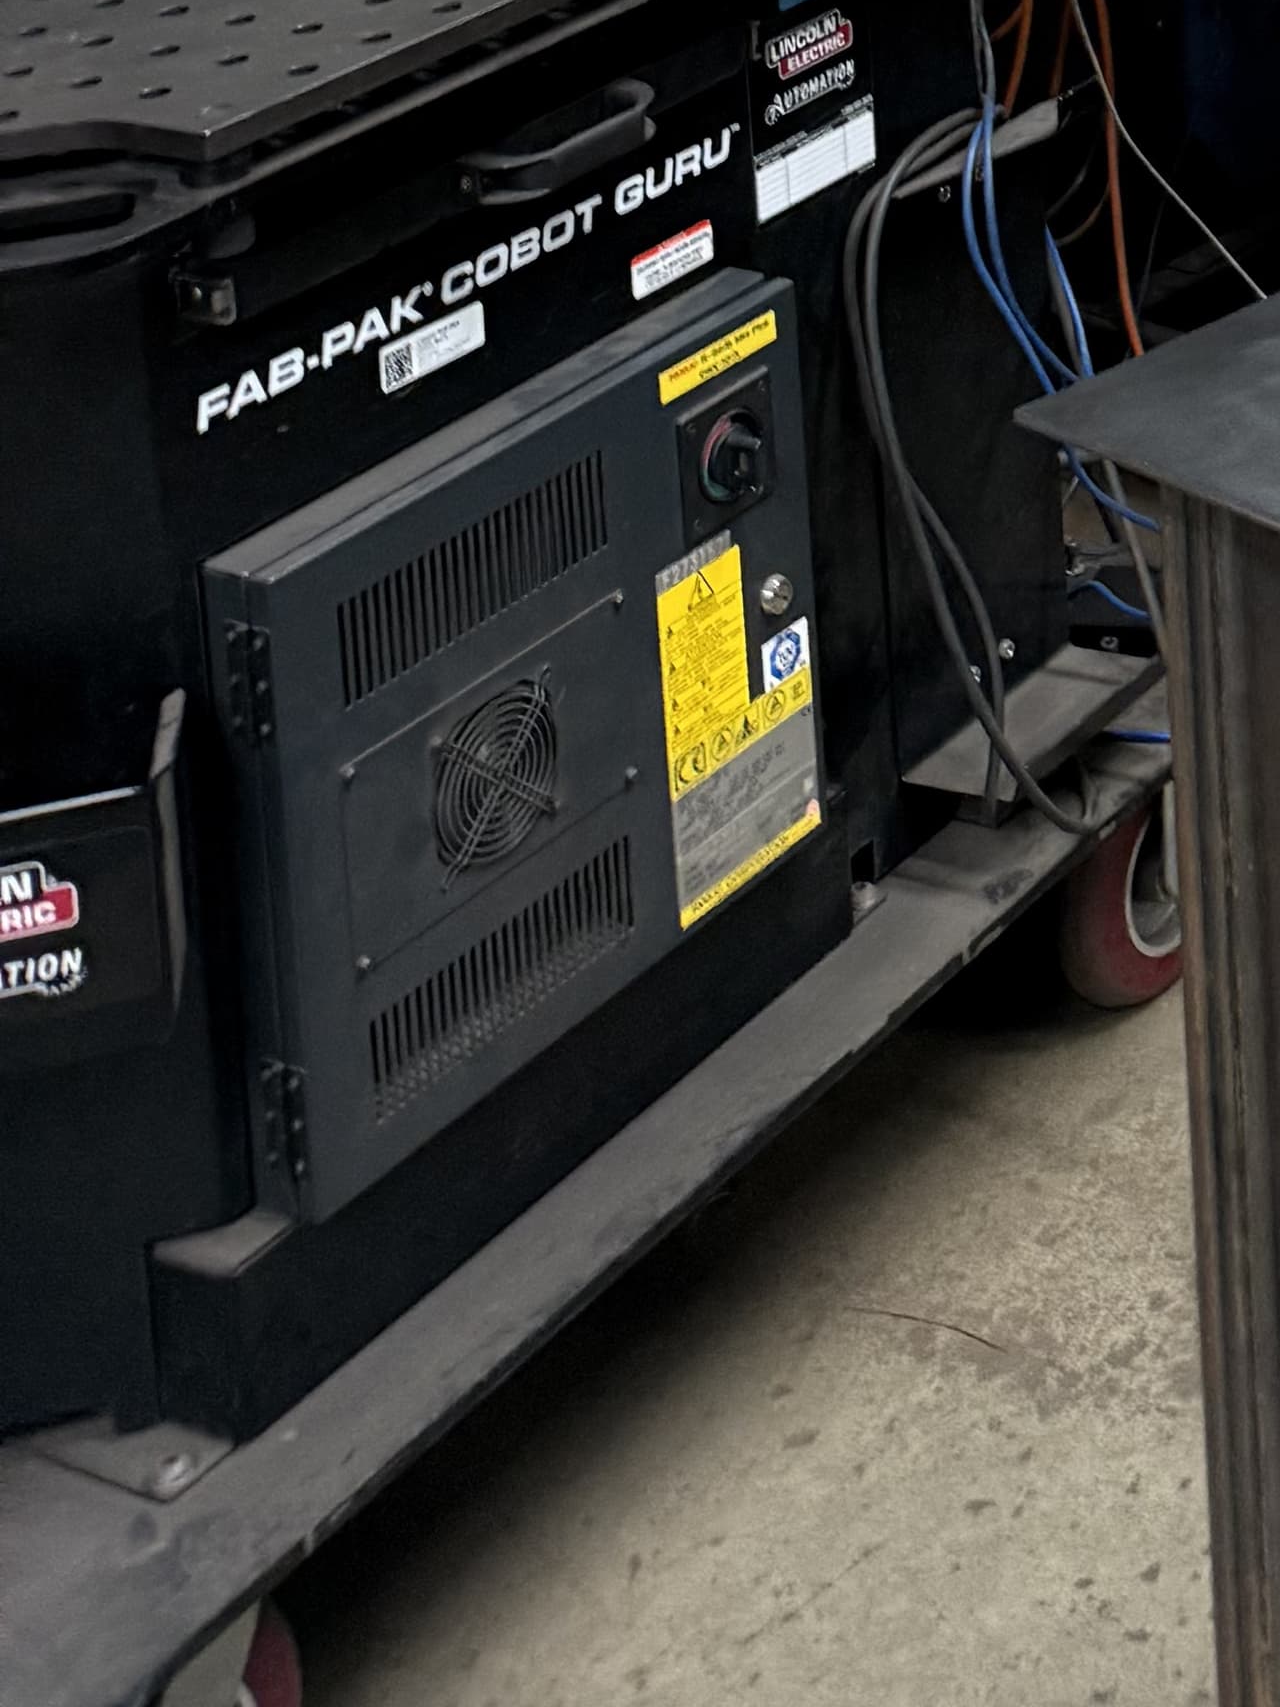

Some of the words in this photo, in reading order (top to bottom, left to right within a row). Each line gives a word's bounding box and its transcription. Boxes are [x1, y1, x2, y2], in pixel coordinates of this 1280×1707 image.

[770, 15, 837, 62] LINCOLN
[787, 31, 846, 72] ELECTRIC
[767, 59, 855, 122] AUTOMATION
[440, 195, 602, 305] COBOT
